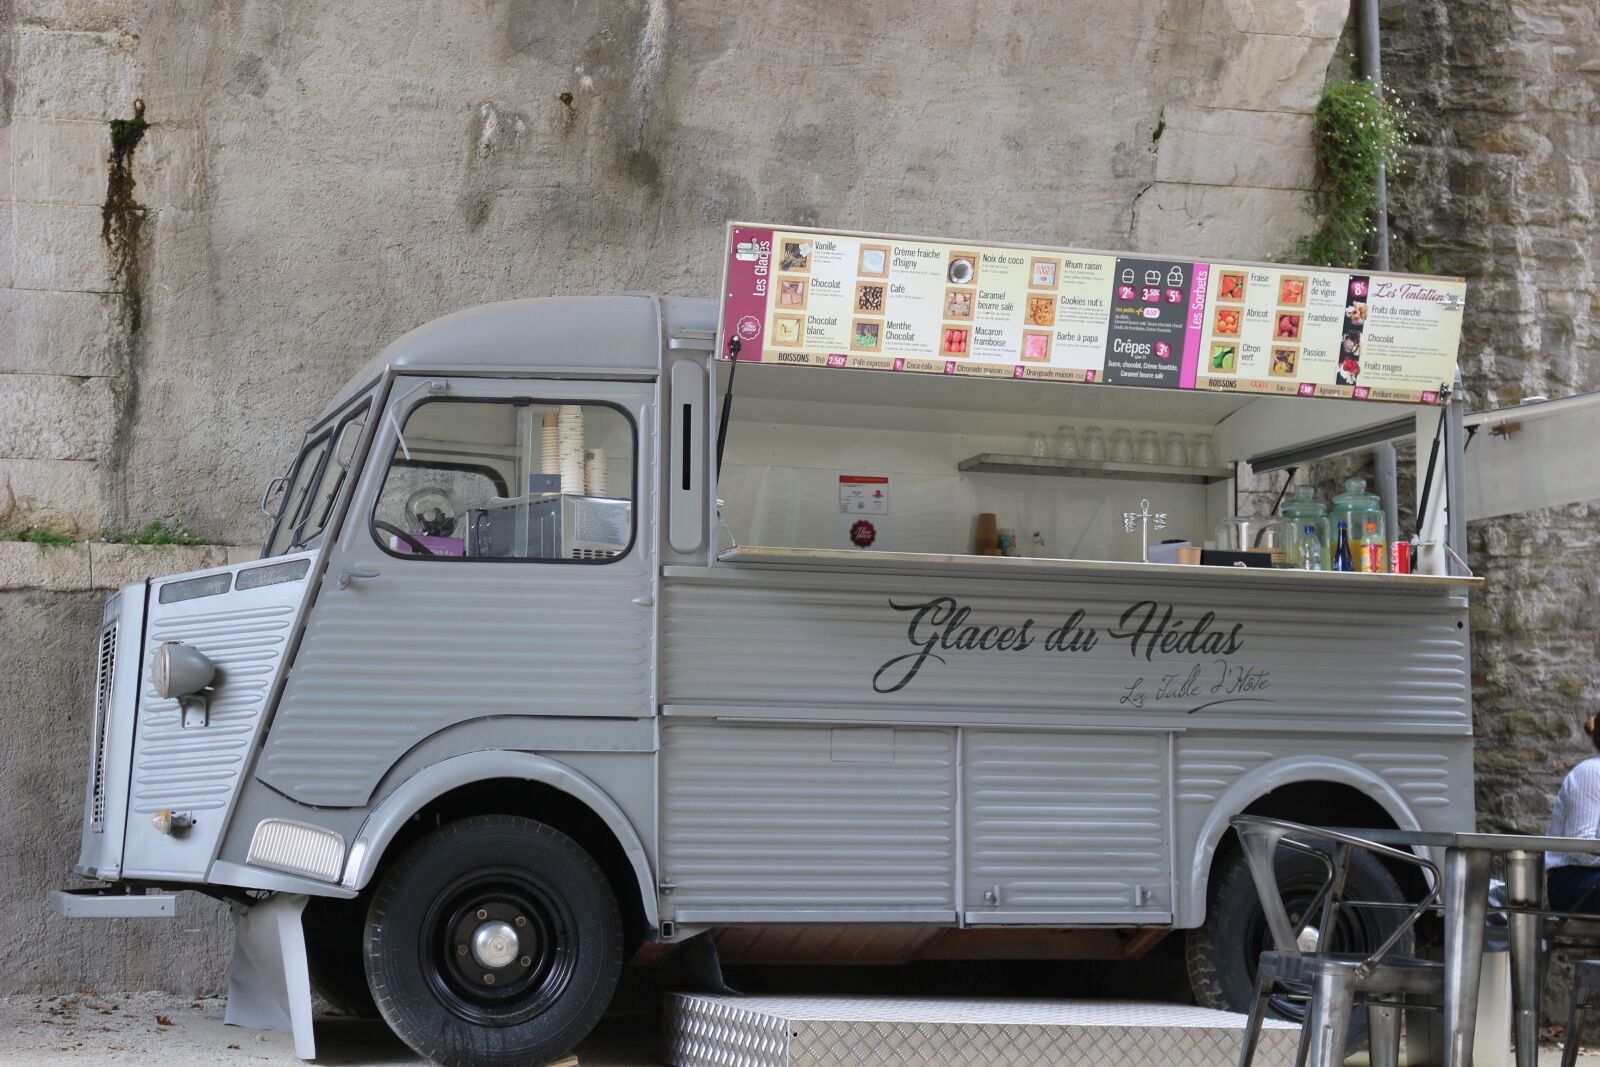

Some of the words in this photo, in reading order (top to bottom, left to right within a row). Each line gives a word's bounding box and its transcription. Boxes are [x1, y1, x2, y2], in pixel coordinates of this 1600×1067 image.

[814, 241, 837, 252] Vanille
[894, 246, 916, 256] Crème
[754, 240, 770, 276] Glaces
[982, 253, 996, 263] Noix
[998, 255, 1006, 264] de
[1064, 260, 1083, 269] Rhum
[1084, 261, 1102, 270] raisin
[811, 278, 841, 289] Chocolat
[1251, 273, 1269, 283] Fraise
[1312, 278, 1331, 287] Pêche
[752, 279, 766, 296] Les
[890, 284, 905, 293] Café
[1192, 270, 1208, 310] Sorbets
[1311, 287, 1319, 296] de
[1320, 289, 1336, 298] vigne
[1372, 283, 1397, 298] Les
[978, 290, 1006, 300] Caramel
[978, 300, 999, 310] beurre
[1000, 302, 1014, 312] salé
[1060, 296, 1086, 306] Cookies
[1087, 298, 1103, 307] nut's
[1246, 308, 1268, 318] Abricot
[1371, 304, 1388, 315] Fruits
[1390, 306, 1397, 314] du
[1398, 307, 1421, 316] marché
[807, 315, 837, 326] Chocolat
[1189, 312, 1202, 330] Les
[1308, 312, 1339, 323] Framboise
[806, 325, 825, 336] blanc
[886, 321, 912, 330] Menthe
[885, 331, 915, 341] Chocolat
[975, 327, 1003, 336] Macaron
[973, 337, 1006, 347] framboise
[1057, 332, 1075, 341] Barbe
[1082, 336, 1098, 345] papa
[1368, 334, 1394, 344] Chocolat
[1113, 338, 1151, 357] Crêpes
[1242, 343, 1261, 353] Citron
[1303, 348, 1326, 357] Passion
[778, 352, 809, 363] BOISSONS
[1241, 353, 1254, 361] vert
[1364, 361, 1380, 370] Fruits
[1382, 363, 1402, 373] rouges
[1208, 379, 1237, 388] BOISSONS
[873, 596, 1034, 693] Glaces
[1045, 608, 1098, 652] du
[1107, 600, 1244, 662] Hédas
